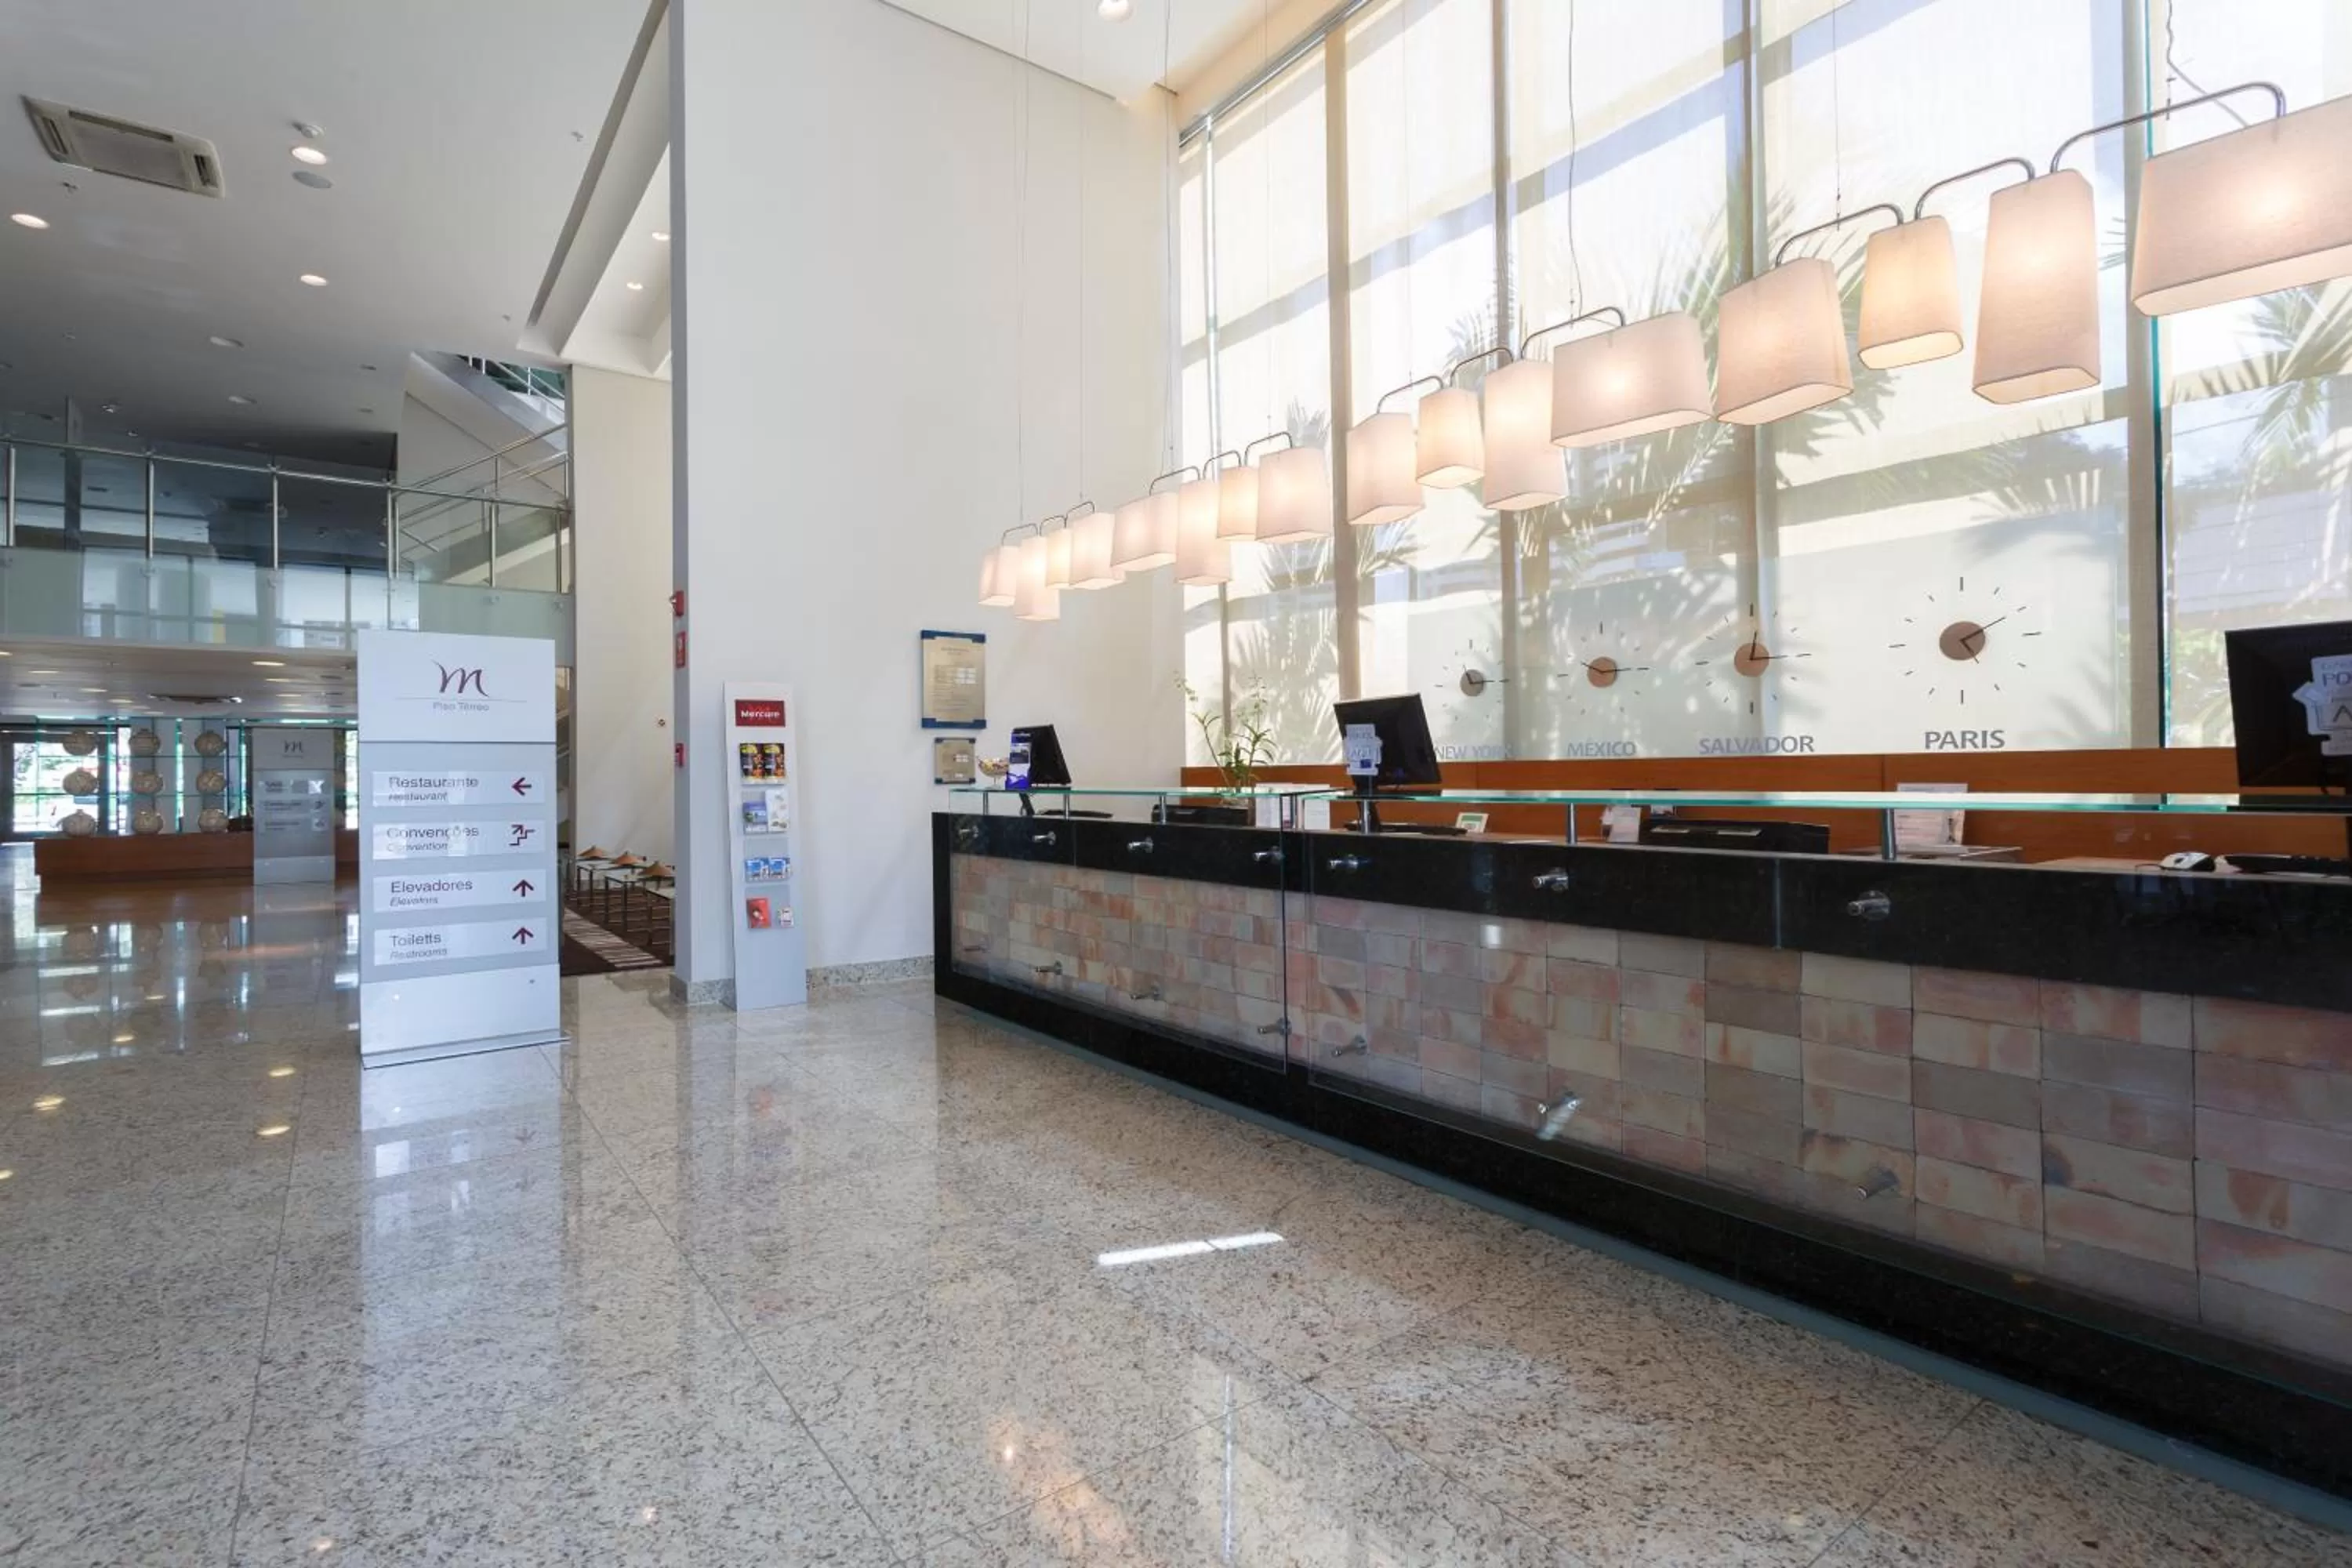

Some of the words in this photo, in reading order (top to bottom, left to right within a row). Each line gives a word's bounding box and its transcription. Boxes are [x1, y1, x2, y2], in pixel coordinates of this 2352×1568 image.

[741, 710, 780, 718] Mercure
[1698, 735, 1815, 755] SALVADOR
[1925, 730, 2005, 750] PARIS
[1433, 746, 1466, 759] NEW
[389, 776, 480, 789] Restaurante
[387, 825, 480, 840] Convenções
[390, 879, 474, 894] Elevadores
